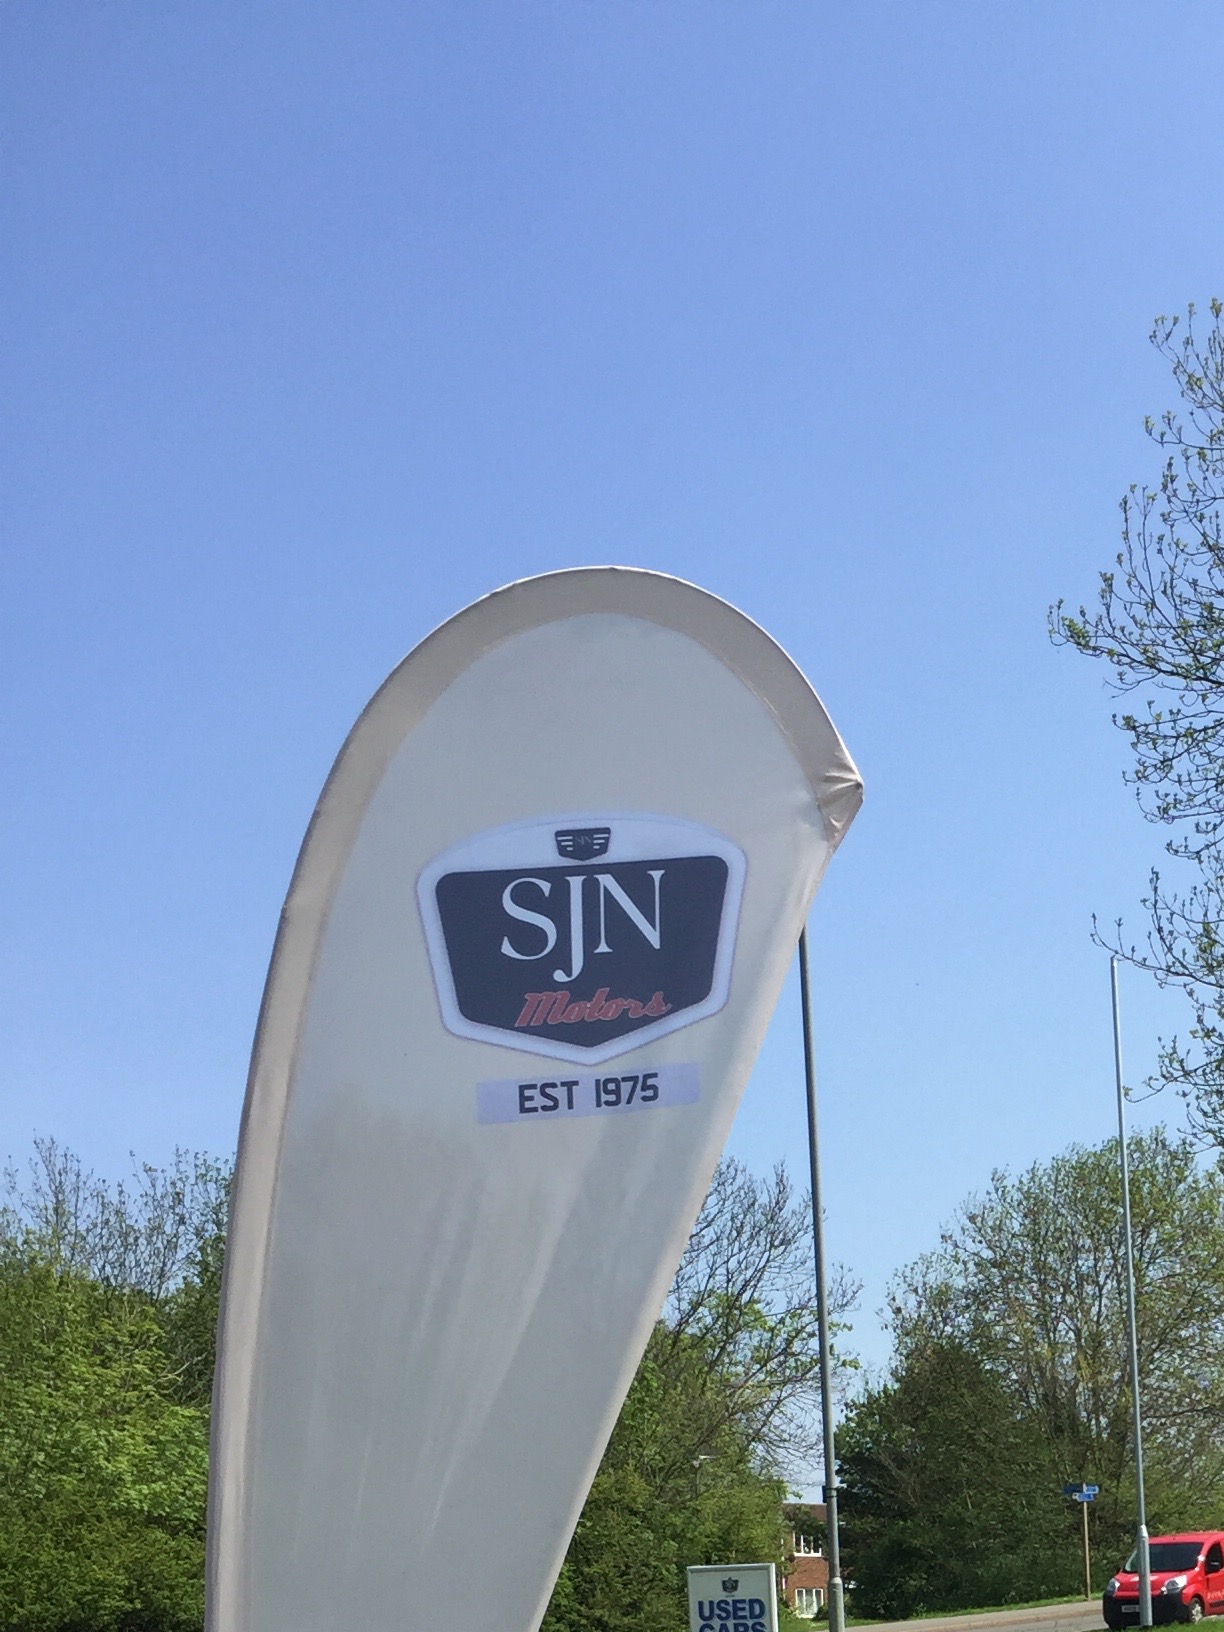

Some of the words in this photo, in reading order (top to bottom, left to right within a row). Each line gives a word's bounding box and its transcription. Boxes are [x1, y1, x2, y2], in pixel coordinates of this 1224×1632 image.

[500, 870, 665, 983] SJN
[515, 988, 672, 1027] Motors
[518, 1081, 579, 1114] EST
[595, 1073, 659, 1109] 1975
[698, 1598, 765, 1622] USED
